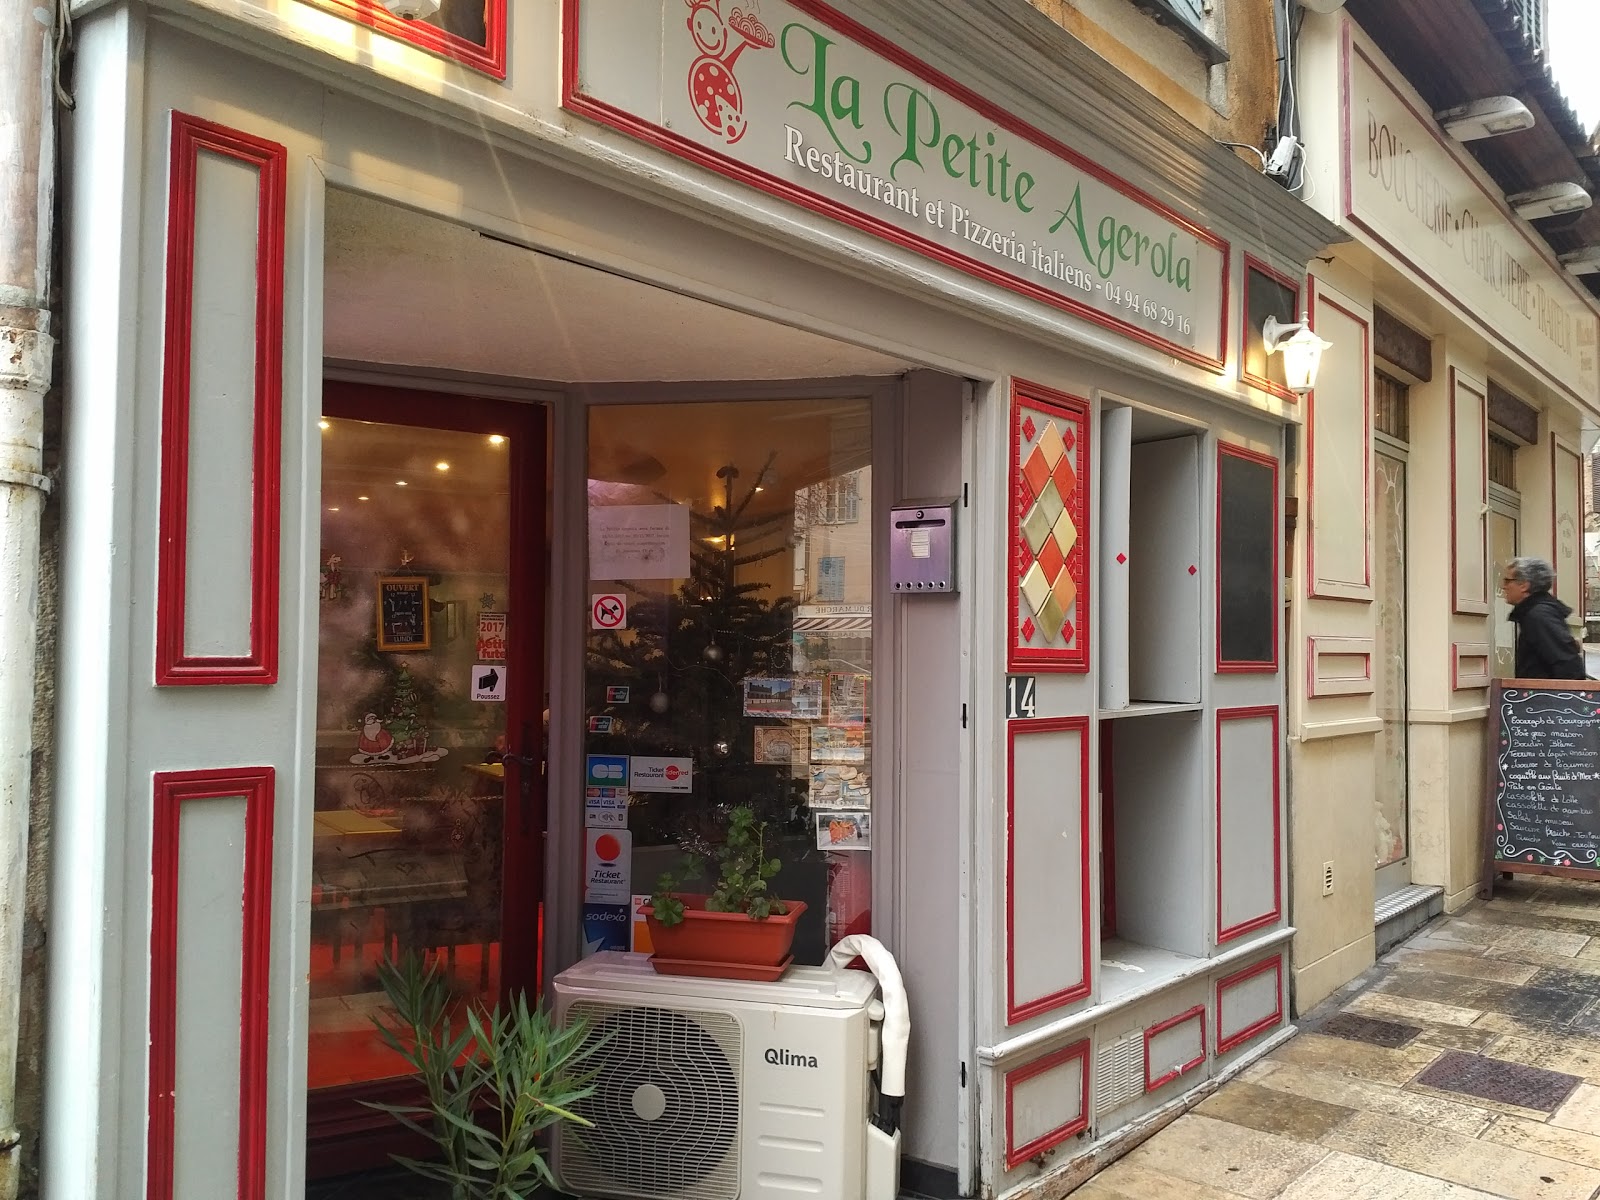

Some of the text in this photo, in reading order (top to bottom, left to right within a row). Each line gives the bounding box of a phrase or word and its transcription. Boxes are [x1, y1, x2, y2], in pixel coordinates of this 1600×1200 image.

[780, 22, 1192, 293] La Petite Agerola
[1367, 108, 1453, 248] BOUCHERIE
[1462, 208, 1531, 320] CHARCUTERIE
[784, 123, 920, 218] Restaurant
[925, 200, 945, 229] et
[950, 201, 1027, 264] Pizzeria
[1031, 240, 1092, 292] italiens
[1105, 281, 1121, 305] 04
[1125, 289, 1140, 314] 94
[1143, 299, 1157, 321] 68
[1160, 306, 1175, 328] 29
[1178, 314, 1190, 335] 16
[481, 622, 504, 632] 2017
[1008, 678, 1035, 717] 14
[1551, 728, 1584, 738] maison
[594, 870, 621, 878] Ticket
[585, 910, 626, 921] sodexo
[764, 1048, 818, 1068] Qlima
